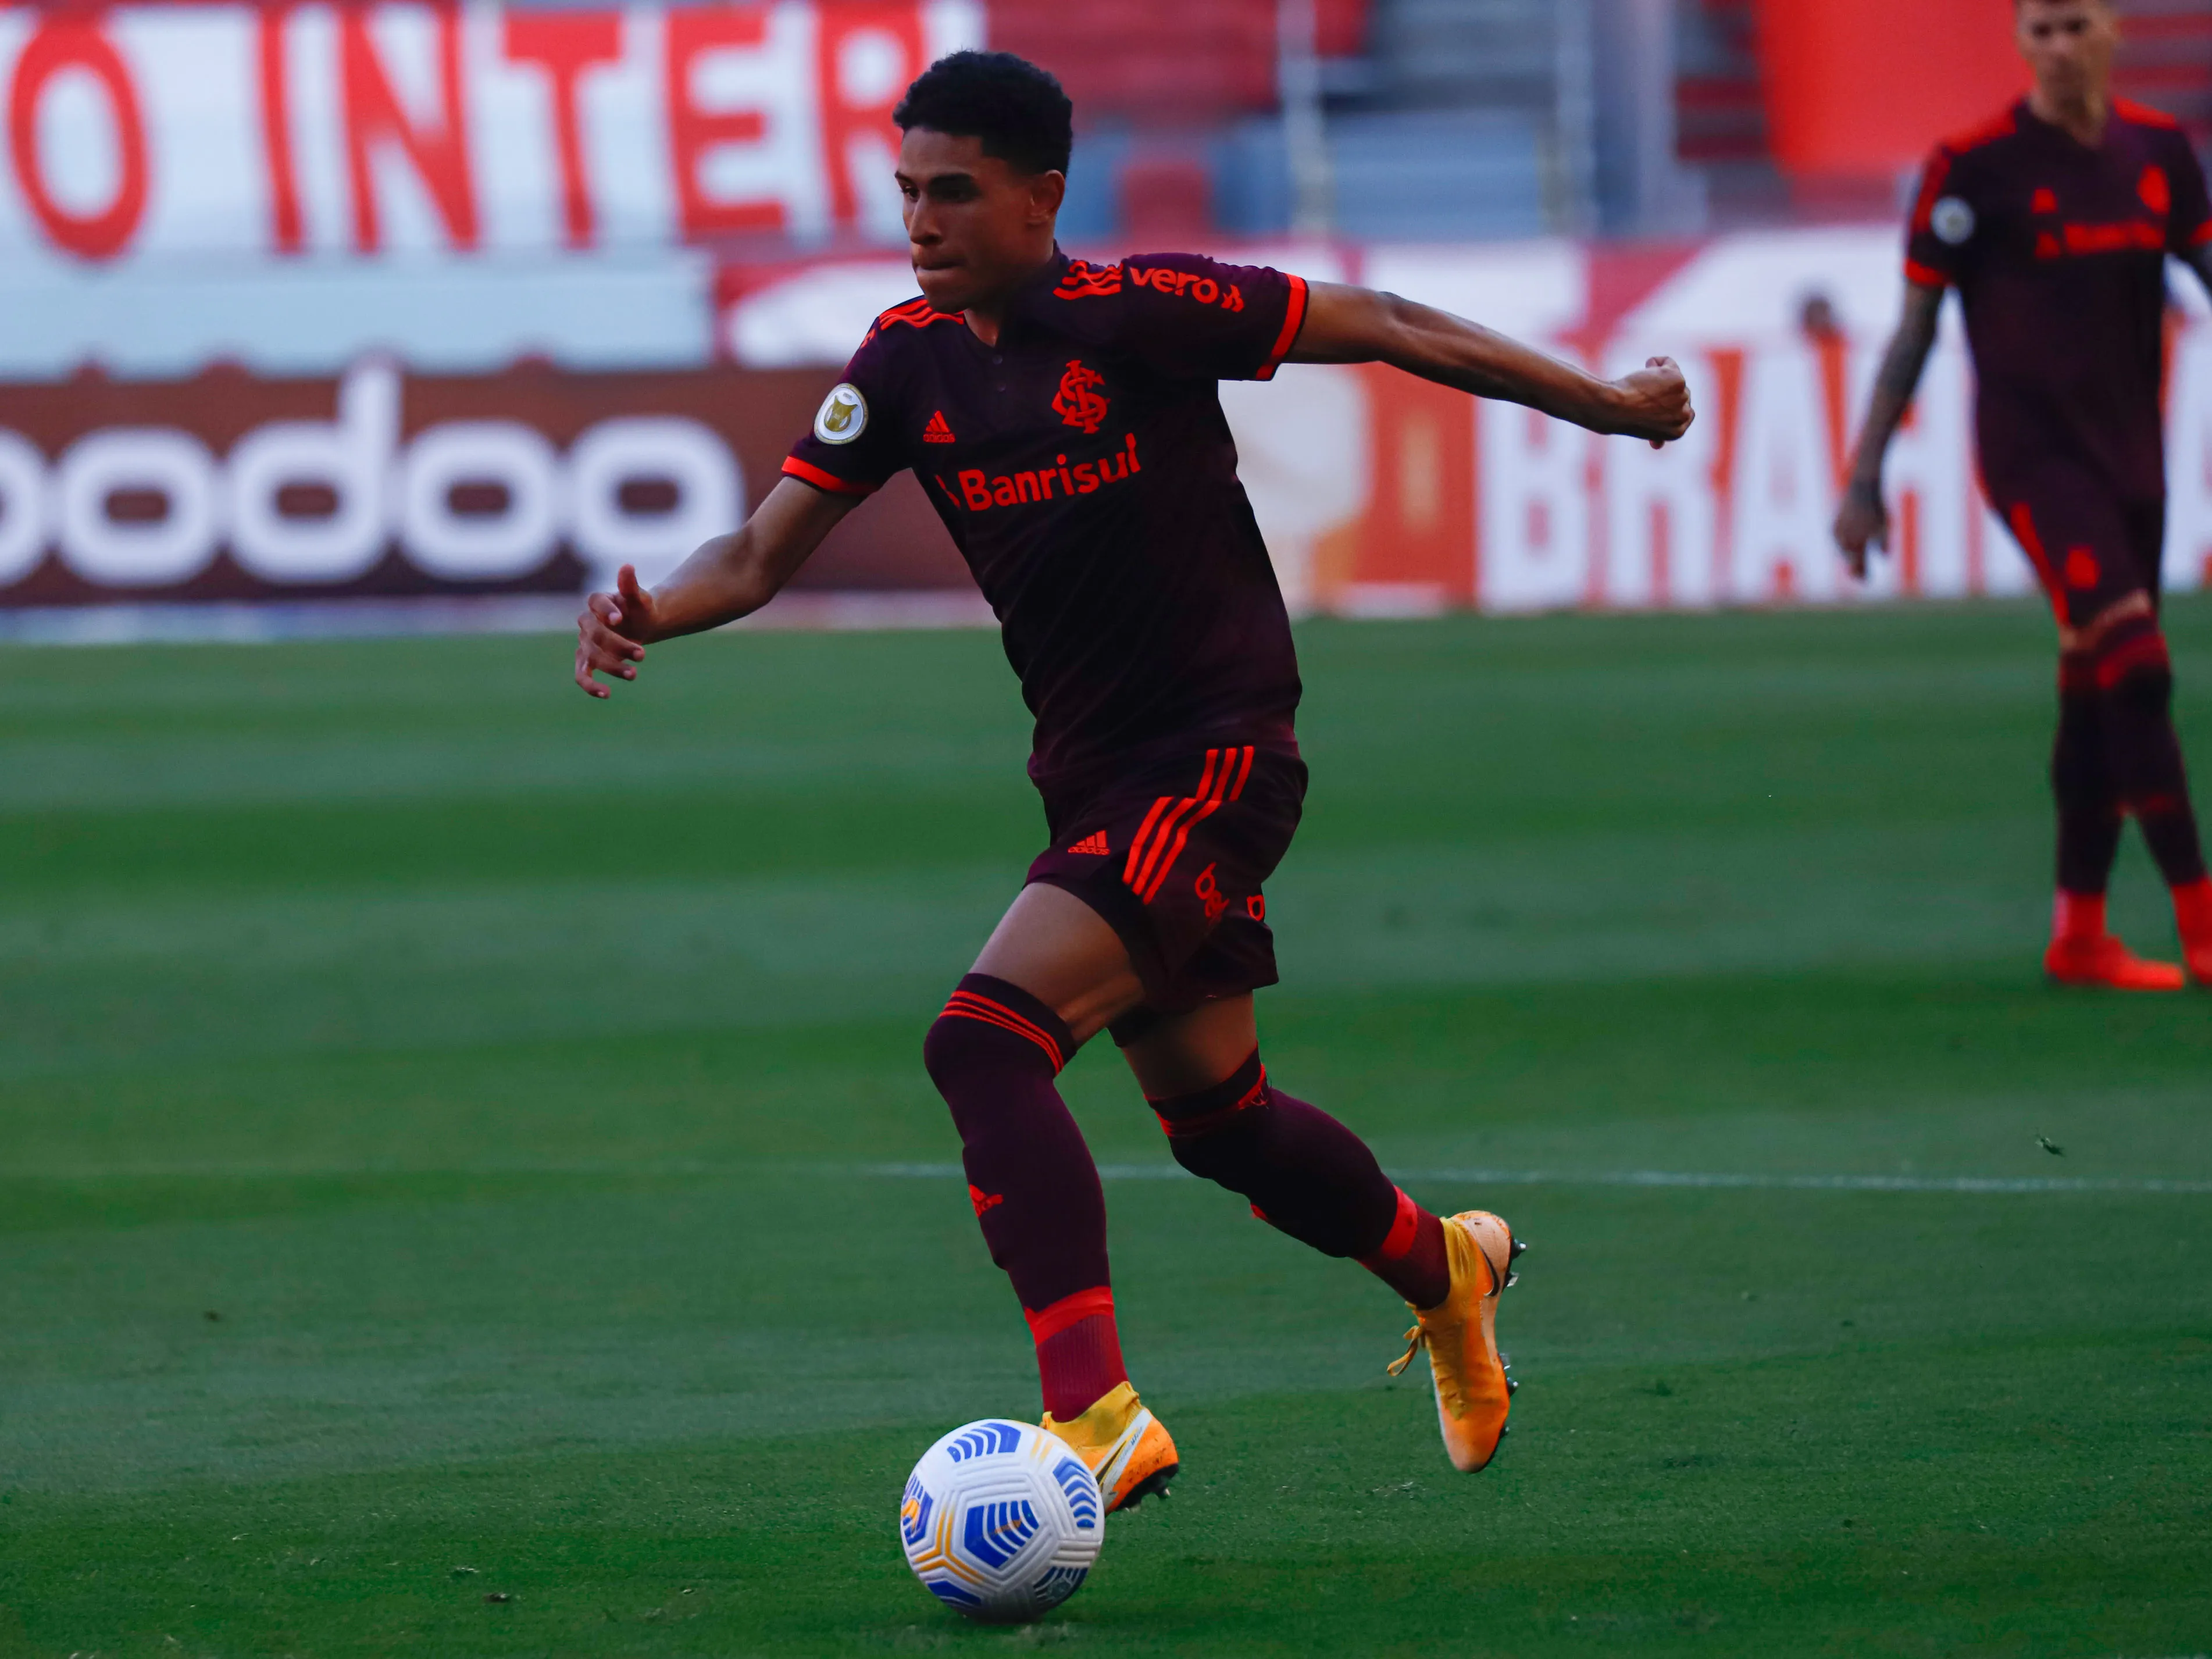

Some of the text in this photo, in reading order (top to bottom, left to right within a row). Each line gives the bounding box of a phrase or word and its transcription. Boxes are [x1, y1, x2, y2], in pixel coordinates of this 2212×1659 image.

[9, 0, 923, 262] O INTER
[1129, 267, 1218, 304] vero
[958, 433, 1141, 511] Banrisul
[1479, 340, 2212, 612] BRAH
